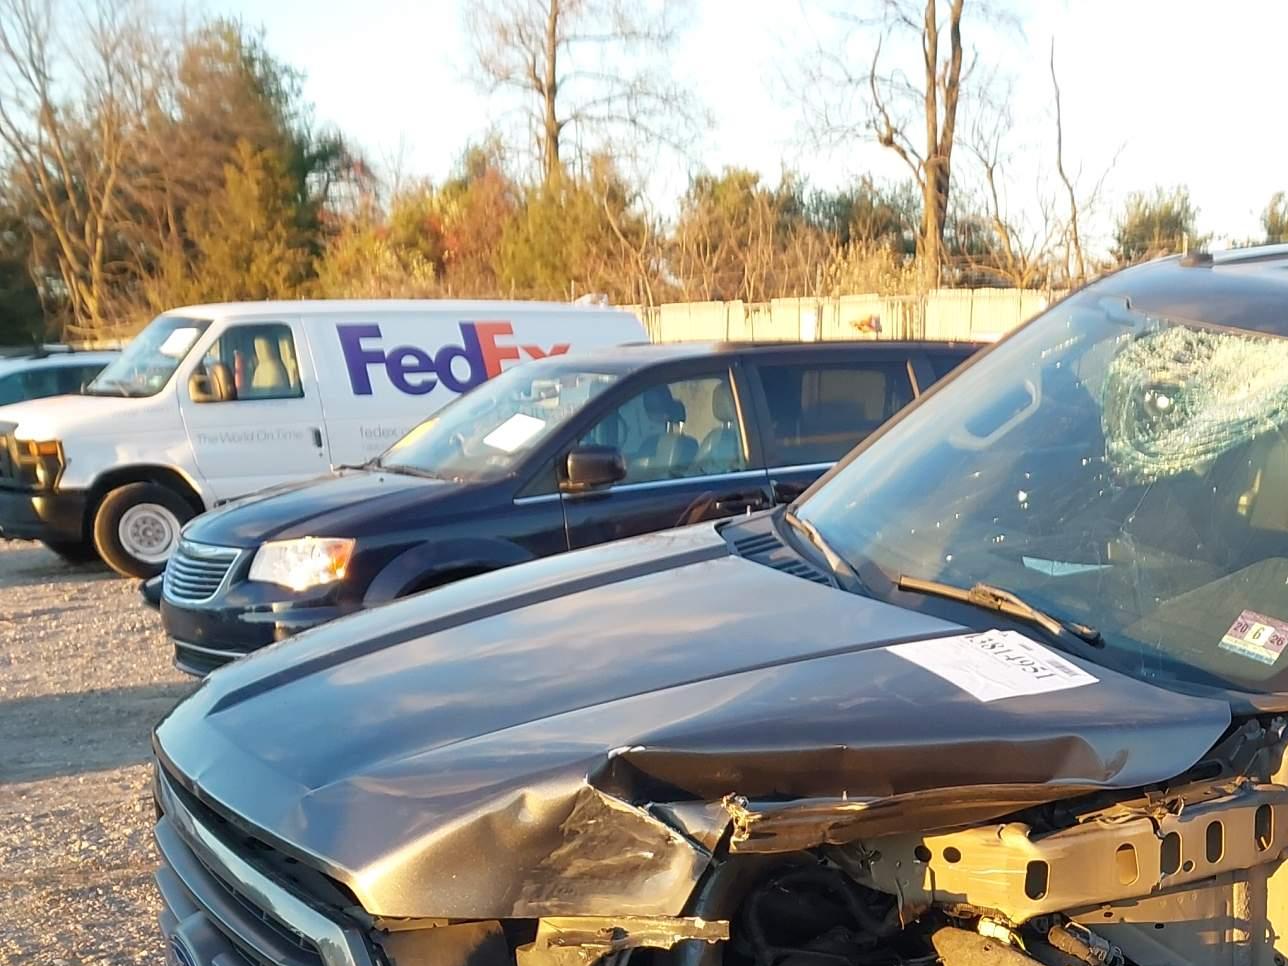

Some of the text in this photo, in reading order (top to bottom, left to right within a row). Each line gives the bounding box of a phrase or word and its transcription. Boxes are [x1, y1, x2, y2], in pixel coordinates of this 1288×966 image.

[336, 320, 570, 396] FedE
[219, 430, 254, 443] World
[1234, 622, 1286, 647] 20 6 26
